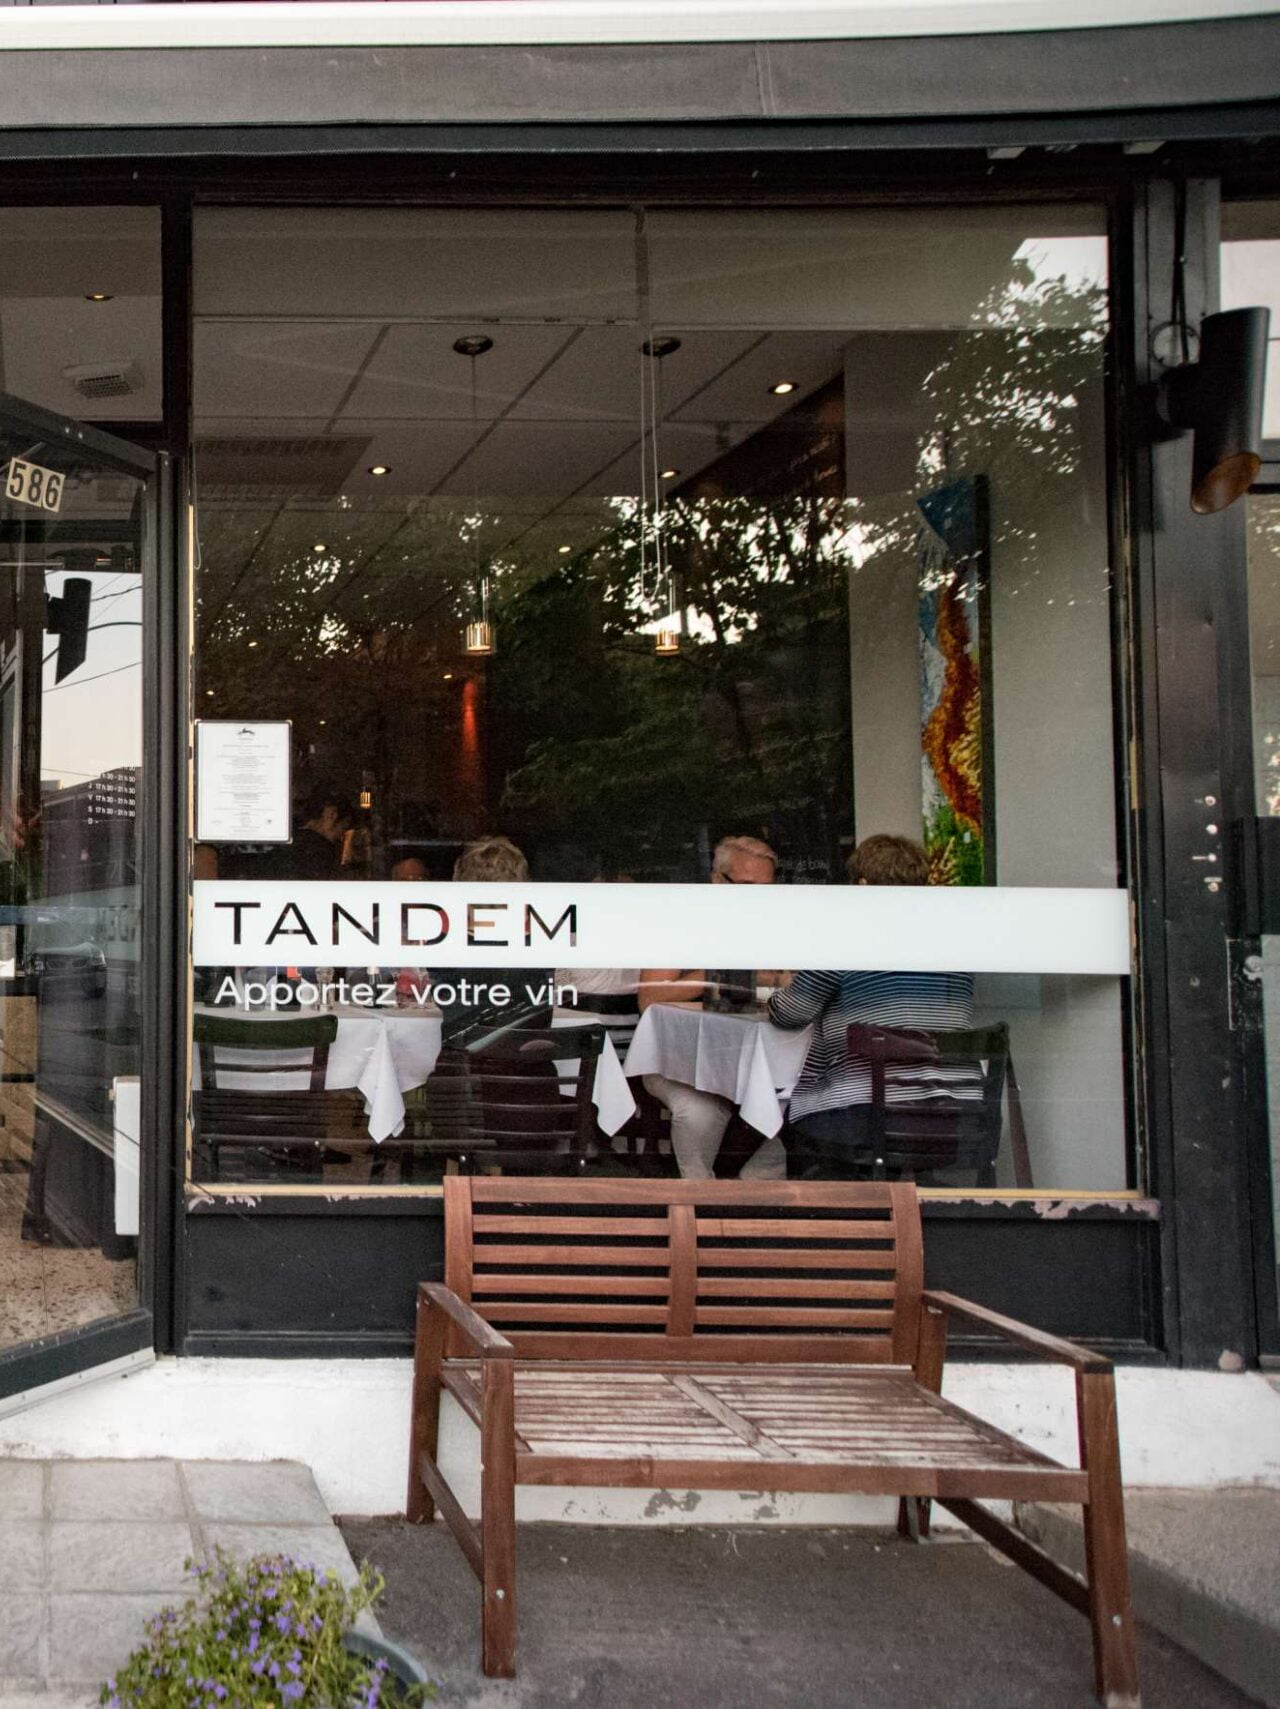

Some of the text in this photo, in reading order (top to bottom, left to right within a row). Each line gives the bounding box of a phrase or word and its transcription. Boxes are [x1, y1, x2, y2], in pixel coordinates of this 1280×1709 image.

[9, 462, 61, 508] 586
[214, 902, 578, 947] TANDEM
[214, 976, 578, 1011] Apportez votre vin
